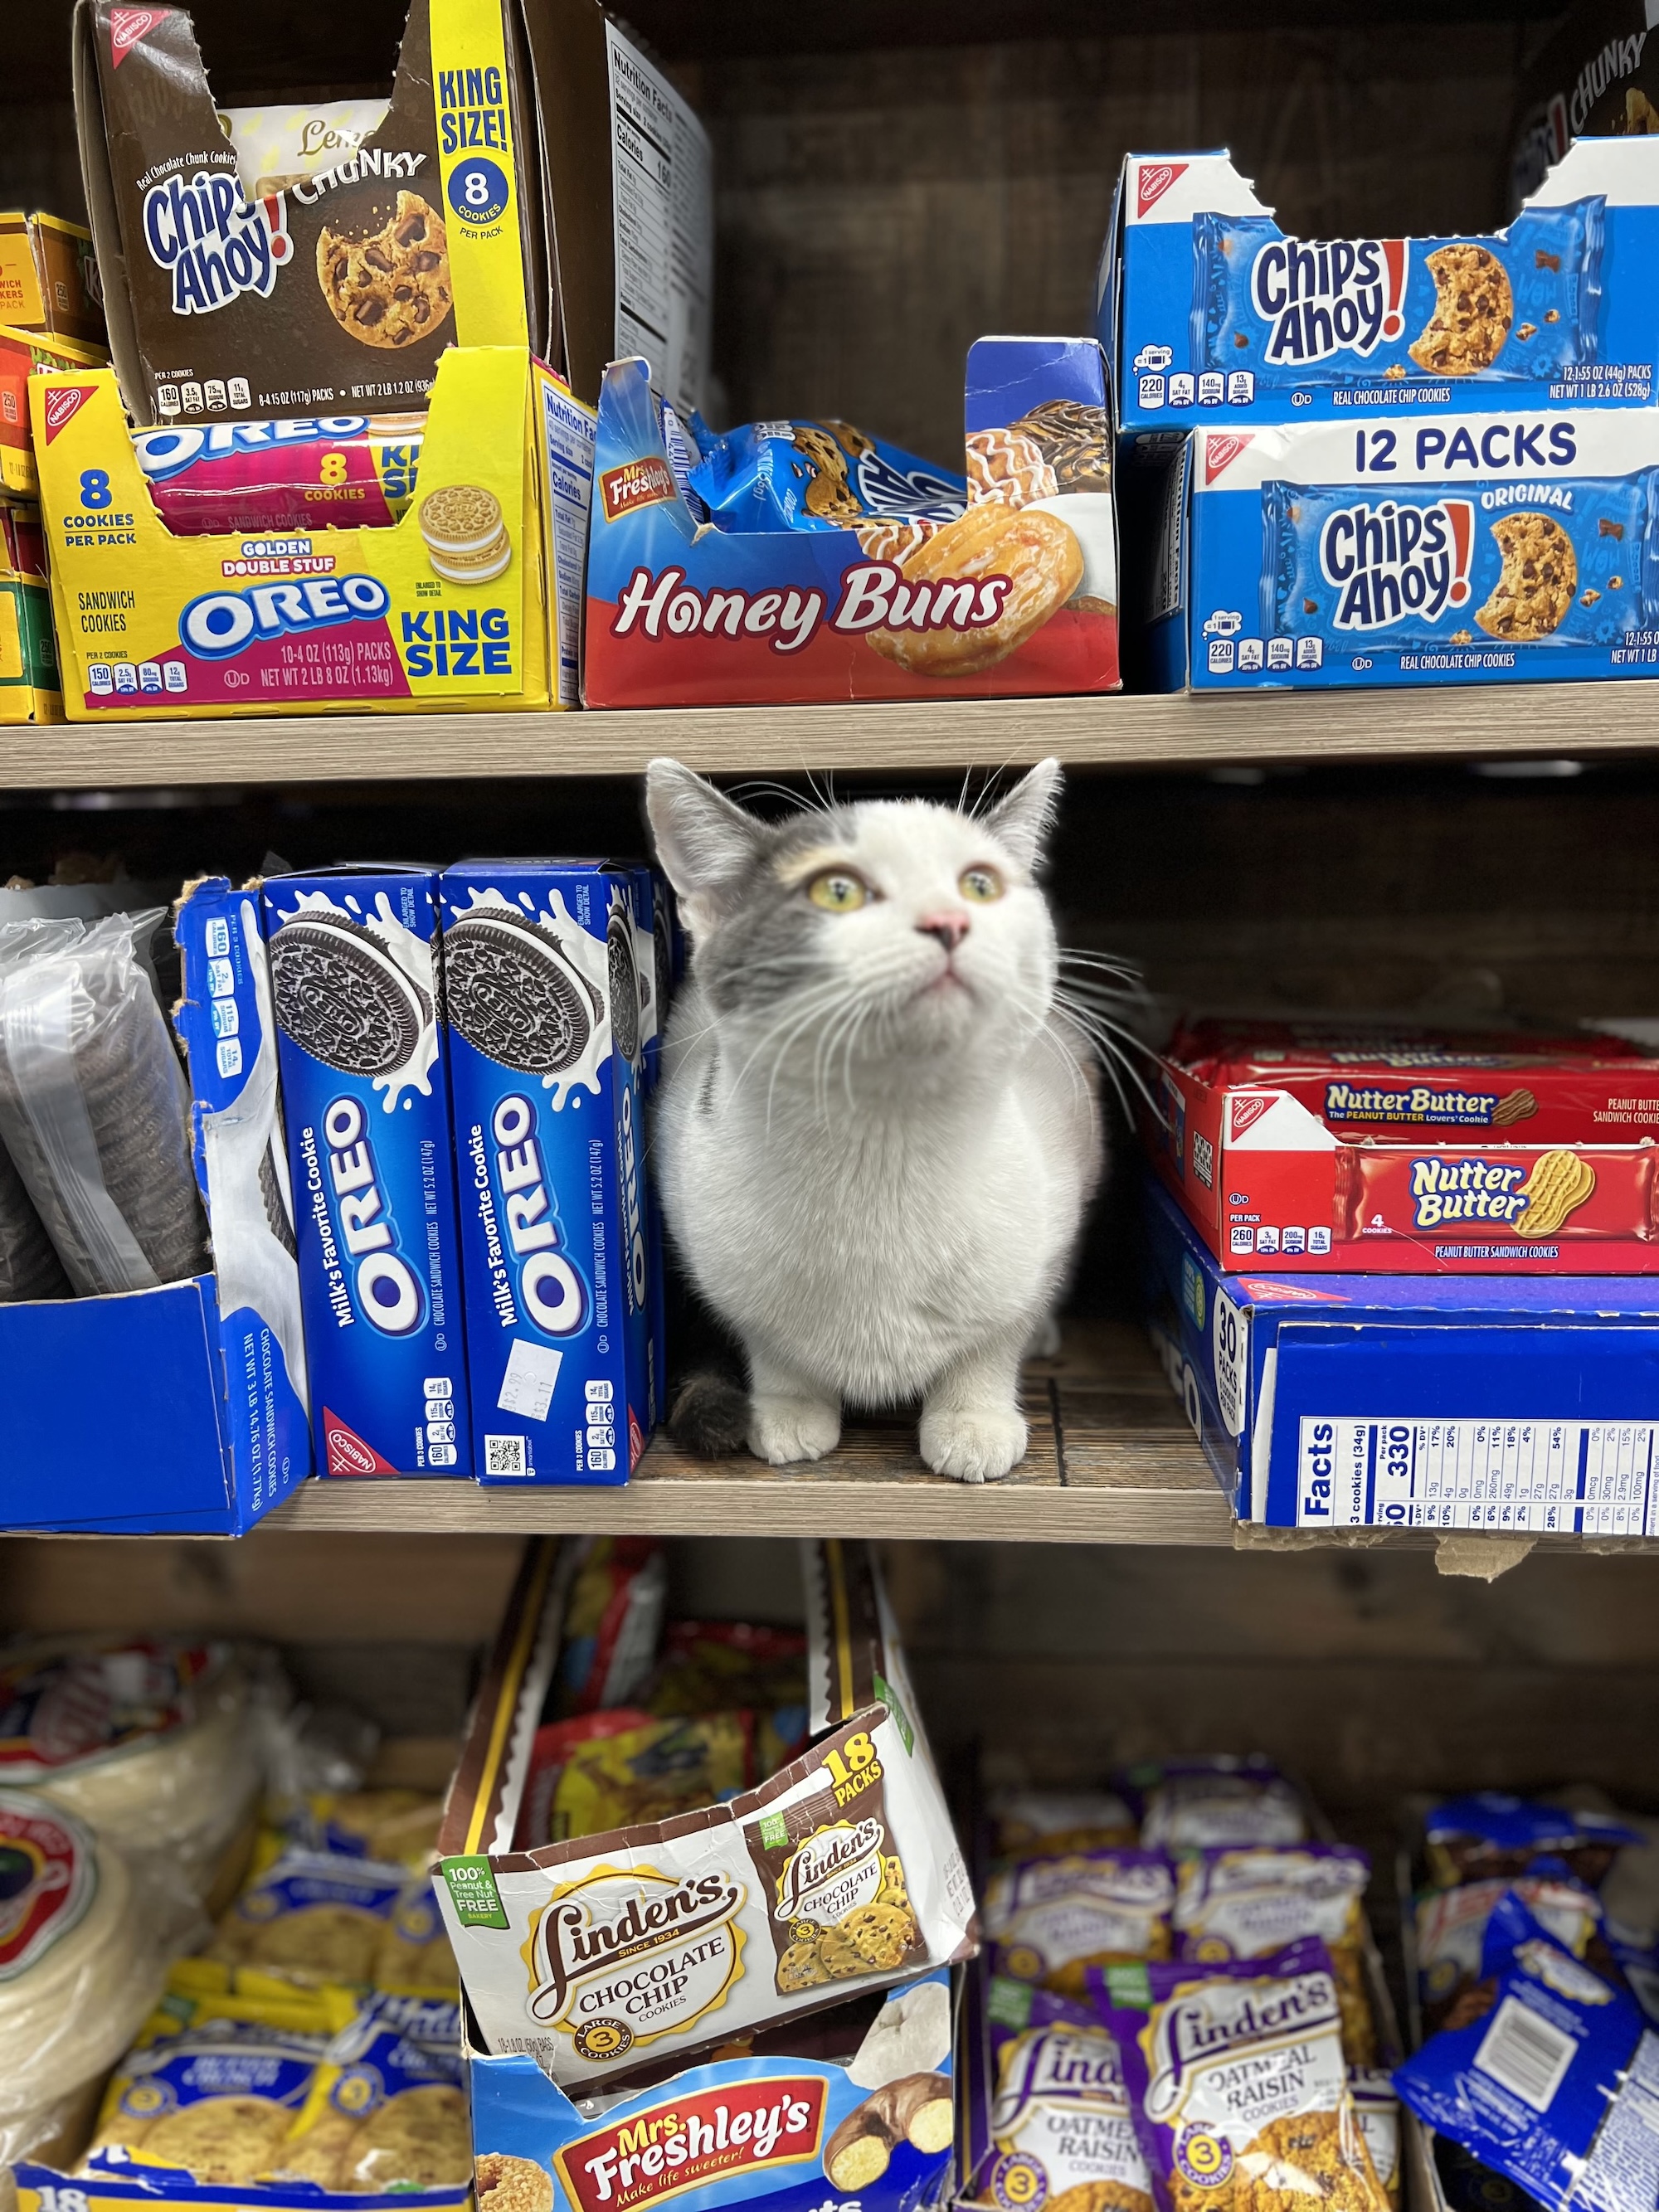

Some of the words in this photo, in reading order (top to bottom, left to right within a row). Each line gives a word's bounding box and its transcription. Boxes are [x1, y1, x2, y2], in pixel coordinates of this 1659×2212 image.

[115, 14, 148, 45] NABISCO
[439, 66, 503, 109] KING
[1570, 32, 1647, 134] CHUNKY
[441, 109, 508, 154] SIZE!
[136, 175, 153, 191] Real
[151, 156, 185, 179] Chocolate
[186, 151, 209, 165] Chunk
[1143, 169, 1170, 198] NABISCO
[465, 172, 489, 206] 8
[458, 203, 501, 222] COOKIES
[460, 227, 479, 240] PER
[480, 226, 504, 240] PACK
[176, 194, 287, 309] Ahoy!
[1257, 239, 1382, 314] Chips
[1271, 240, 1404, 359] Ahoy!
[1141, 378, 1162, 392] 220
[1593, 367, 1604, 381] OZ
[1605, 366, 1627, 383] (44g)
[1627, 365, 1652, 380] PACKS
[50, 391, 79, 423] NABISCO
[280, 391, 290, 405] OZ
[290, 389, 312, 406] (117g)
[313, 387, 333, 401] PACKS
[1332, 391, 1353, 406] REAL
[1353, 389, 1399, 405] CHOCOLATE
[1399, 389, 1417, 403] CHIP
[1418, 387, 1451, 403] COOKIES
[136, 416, 364, 471] OREO
[1210, 436, 1238, 466] NABISCO
[1356, 429, 1398, 472] 12
[1416, 422, 1578, 470] PACKS
[319, 453, 348, 485] 8
[80, 469, 113, 509] 8
[304, 487, 366, 502] COOKIES
[1481, 484, 1574, 510] ORIGINAL
[63, 513, 134, 529] COOKIES
[66, 533, 95, 547] PER
[98, 532, 137, 546] PACK
[242, 540, 311, 556] GOLDEN
[1326, 504, 1447, 581] Chips
[223, 559, 290, 576] DOUBLE
[292, 557, 335, 572] STUF
[1340, 503, 1472, 625] Ahoy!
[78, 590, 135, 610] SANDWICH
[187, 577, 385, 649] OREO
[615, 571, 821, 650] Honey
[834, 566, 1007, 630] Buns
[81, 613, 127, 633] COOKIES
[401, 607, 510, 643] KING
[281, 644, 304, 664] 10-4
[306, 644, 320, 663] OZ
[322, 640, 354, 666] (113g)
[358, 641, 392, 662] PACKS
[406, 641, 513, 677] SIZE
[1211, 644, 1232, 657] 220
[1400, 655, 1419, 669] REAL
[1420, 654, 1462, 669] CHOCOLATE
[1464, 654, 1482, 668] CHIP
[1482, 653, 1515, 668] COOKIES
[260, 668, 280, 687] NET
[282, 667, 299, 686] WT
[301, 667, 309, 686] 2
[310, 666, 324, 685] LB
[326, 665, 333, 684] 8
[335, 664, 349, 684] OZ
[352, 663, 394, 687] (1.13kg)
[1236, 1101, 1262, 1125] NABISCO
[1327, 1085, 1409, 1111] Nutter
[1410, 1088, 1494, 1114] Butter
[1329, 1111, 1345, 1119] The
[1346, 1111, 1385, 1121] PEANUT
[1386, 1112, 1424, 1121] BUTTER
[1426, 1113, 1458, 1122] Lovers'
[1459, 1115, 1489, 1123] Cookie
[300, 1126, 323, 1191] Cookie
[420, 1140, 435, 1164] (147g)
[469, 1124, 489, 1189] Cookie
[422, 1165, 435, 1176] OZ
[424, 1177, 435, 1189] 5.2
[1413, 1160, 1521, 1195] Nutter
[424, 1191, 437, 1203] WT
[426, 1203, 438, 1215] NET
[494, 1096, 581, 1331] OREO
[1417, 1189, 1525, 1227] Butter
[312, 1192, 339, 1270] Favorite
[324, 1098, 419, 1331] OREO
[478, 1190, 504, 1269] Favorite
[1371, 1213, 1384, 1226] 4
[426, 1221, 440, 1251] COOKIES
[1233, 1229, 1252, 1240] 260
[1435, 1246, 1462, 1258] PEANUT
[1463, 1246, 1490, 1258] BUTTER
[1490, 1246, 1528, 1258] SANDWICH
[1528, 1246, 1559, 1258] COOKIES
[428, 1252, 442, 1287] SANDWICH
[329, 1270, 355, 1328] Milk's
[431, 1288, 445, 1326] CHOCOLATE
[493, 1268, 518, 1327] Milk's
[1219, 1300, 1236, 1364] 30
[260, 1328, 274, 1392] CHOCOLATE
[1219, 1350, 1238, 1393] PACKS
[504, 1372, 523, 1404] $2.99
[533, 1381, 553, 1414] $3.11
[265, 1393, 276, 1451] SANDWICH
[1431, 1426, 1440, 1447] 17%
[1446, 1426, 1456, 1448] 20%
[333, 1433, 372, 1469] NABISCO
[1353, 1425, 1366, 1458] (34g)
[1387, 1426, 1410, 1477] 330
[267, 1451, 277, 1498] COOKIES
[1304, 1423, 1333, 1516] Facts
[1351, 1461, 1362, 1512] cookies
[821, 1731, 875, 1788] 18
[834, 1759, 883, 1808] PACKS
[449, 1867, 485, 1881] 100%
[450, 1881, 484, 1889] Peanut
[485, 1880, 493, 1889] &
[776, 1820, 881, 1918] Linden's
[454, 1890, 474, 1898] Tree
[476, 1890, 494, 1898] Nut
[804, 1862, 878, 1913] CHOCOLATE
[827, 1888, 859, 1914] CHIP
[456, 1899, 499, 1912] FREE
[532, 1874, 738, 2020] Linden's
[618, 1941, 651, 1957] SINCE
[653, 1928, 680, 1945] 1934
[579, 1936, 726, 2013] CHOCOLATE
[625, 1975, 689, 2015] CHIP
[638, 1996, 687, 2023] COOKIES
[577, 2018, 621, 2038] LARGE
[593, 2031, 614, 2047] 3
[580, 2033, 630, 2060] COOKIES
[1146, 1977, 1330, 2119] Linden's
[1226, 2069, 1305, 2113] RAISIN
[1243, 2095, 1299, 2122] COOKIES
[584, 2094, 811, 2201] Freshley's
[617, 2113, 687, 2156] Mrs.
[616, 2181, 654, 2208] Make
[659, 2171, 680, 2187] life
[684, 2146, 745, 2178] sweeter!
